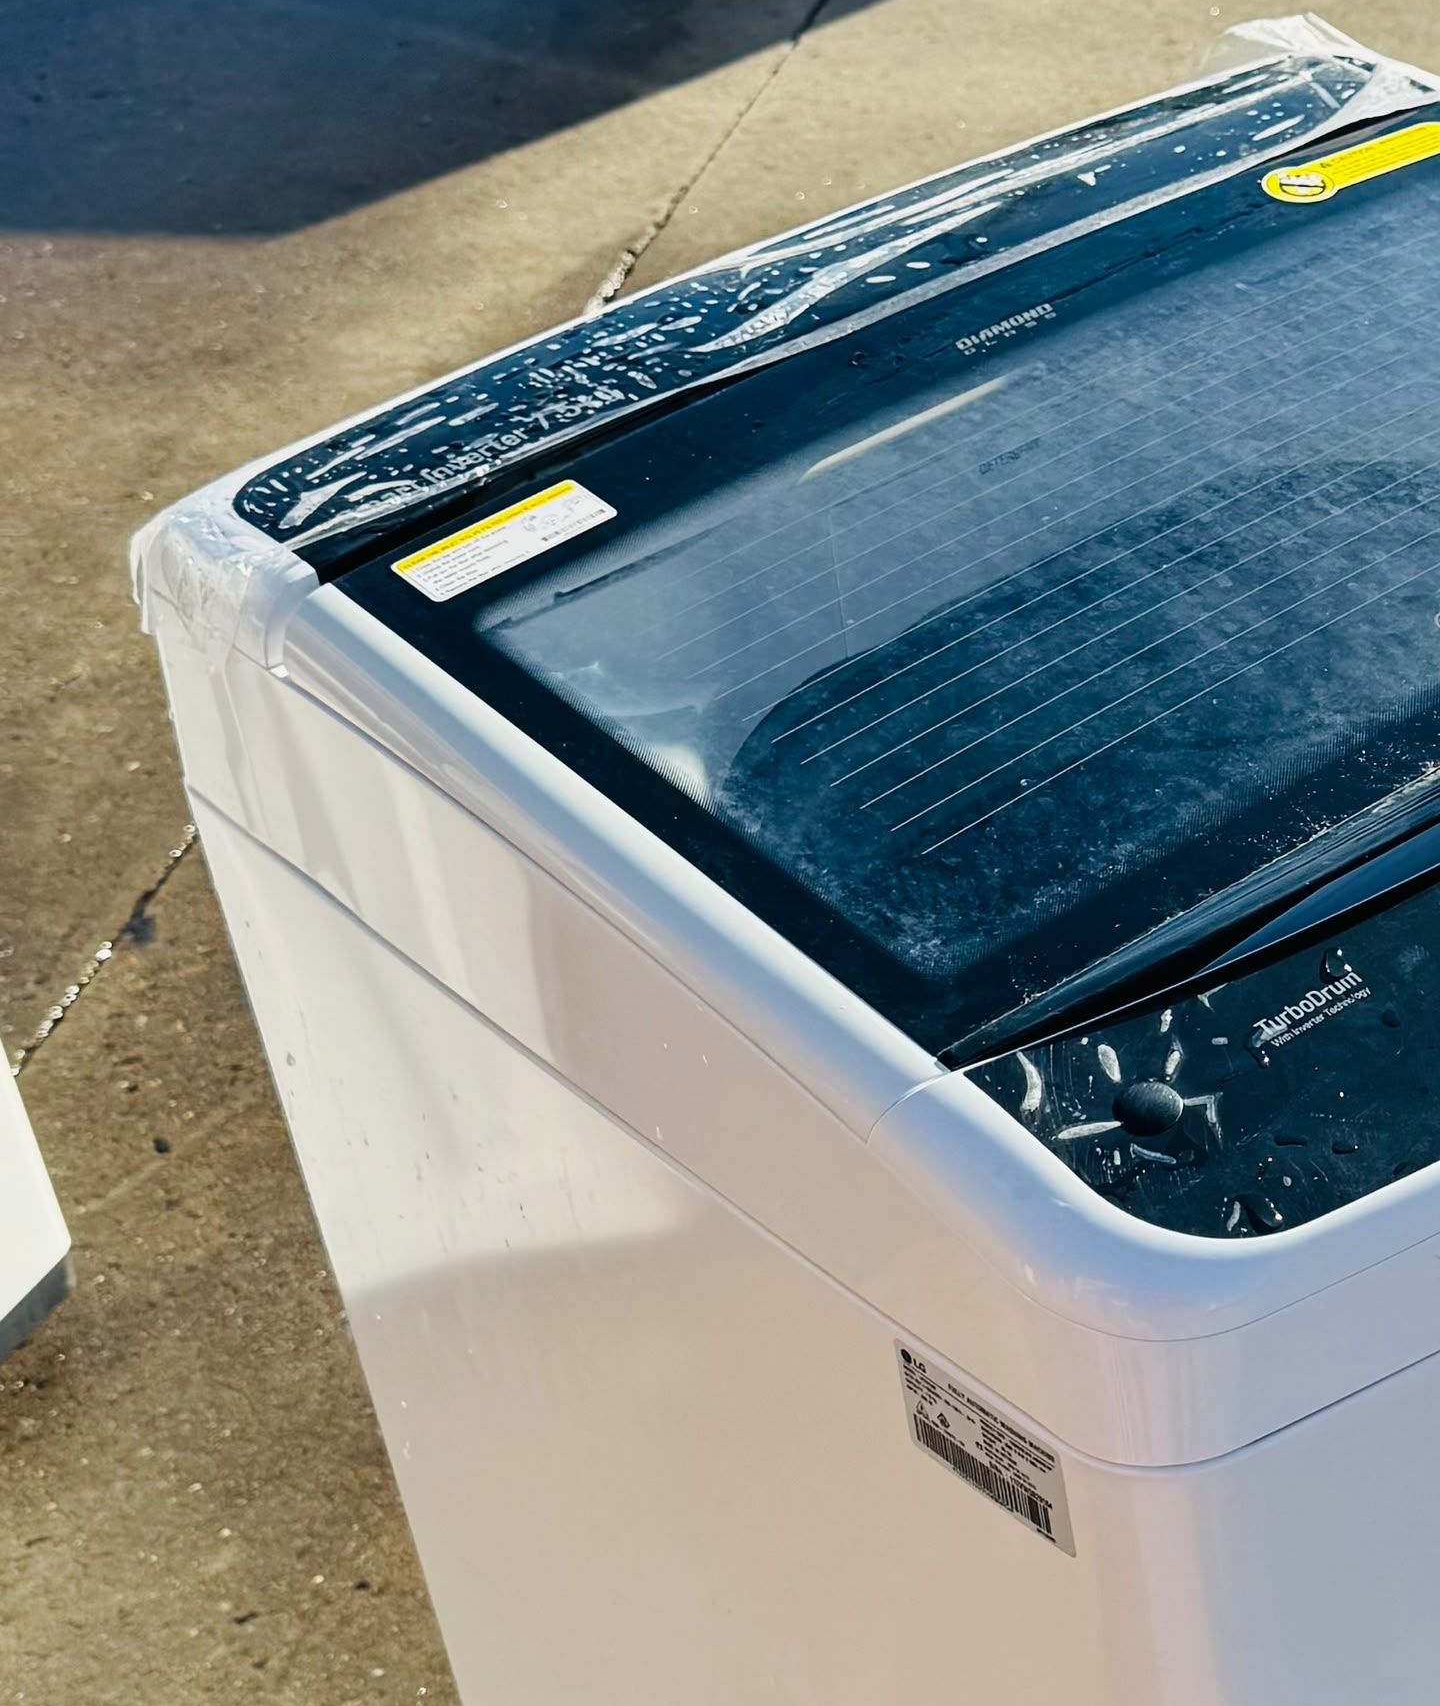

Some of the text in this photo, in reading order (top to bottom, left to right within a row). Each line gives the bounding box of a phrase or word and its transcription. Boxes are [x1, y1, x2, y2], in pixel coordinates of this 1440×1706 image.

[955, 303, 1054, 351] DIAMOND
[1252, 972, 1363, 1035] TurboDrum
[1270, 987, 1371, 1047] With Inverter Technology
[913, 1358, 927, 1374] LG
